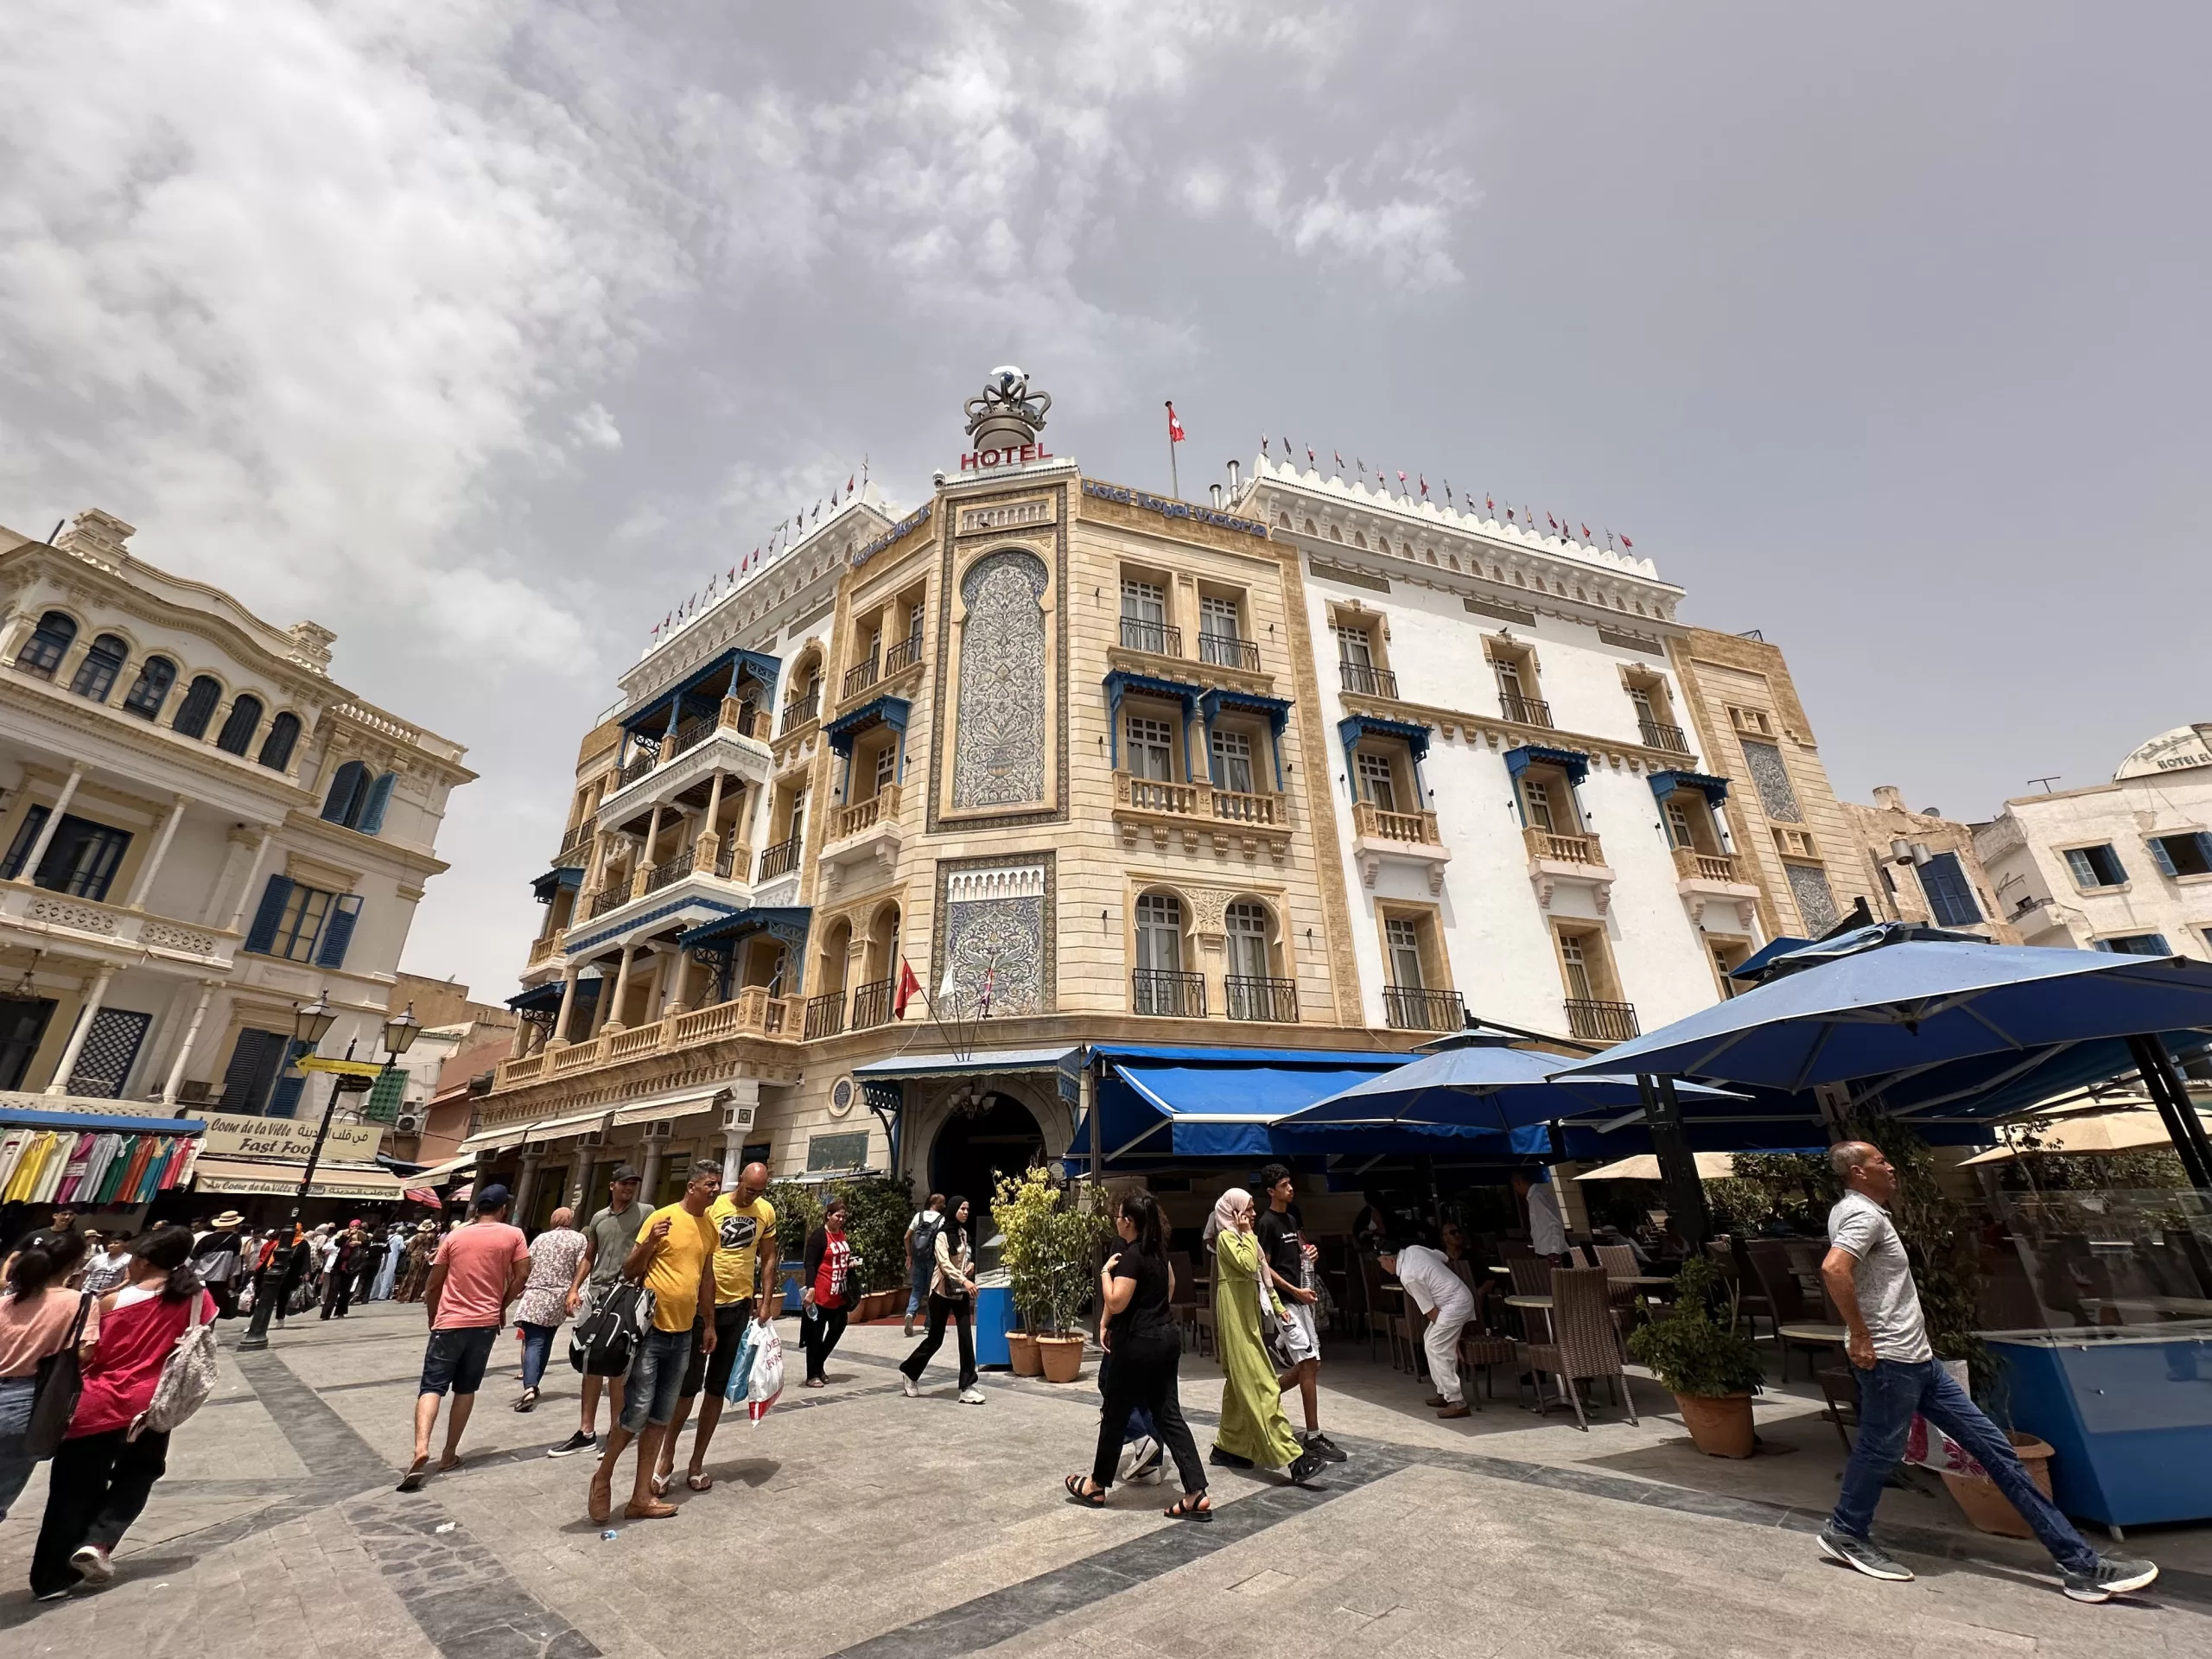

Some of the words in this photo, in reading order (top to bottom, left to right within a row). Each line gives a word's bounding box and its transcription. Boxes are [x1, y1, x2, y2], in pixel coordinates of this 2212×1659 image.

[961, 442, 1053, 470] HOTEL
[1083, 480, 1131, 505] Hotel
[1136, 492, 1191, 518] Royal
[1194, 505, 1267, 537] Victoria
[2157, 755, 2197, 770] HOTEL
[211, 1118, 240, 1133] Coeur
[240, 1120, 252, 1134] de
[254, 1122, 266, 1135] la
[268, 1122, 291, 1136] Ville
[332, 1128, 352, 1141] قلب
[238, 1138, 277, 1154] Fast
[281, 1141, 312, 1154] Foo
[352, 1130, 369, 1146] في
[207, 1179, 220, 1189] Au
[222, 1180, 246, 1191] Coeur
[248, 1182, 258, 1192] de
[259, 1182, 270, 1192] la
[271, 1183, 292, 1193] Ville
